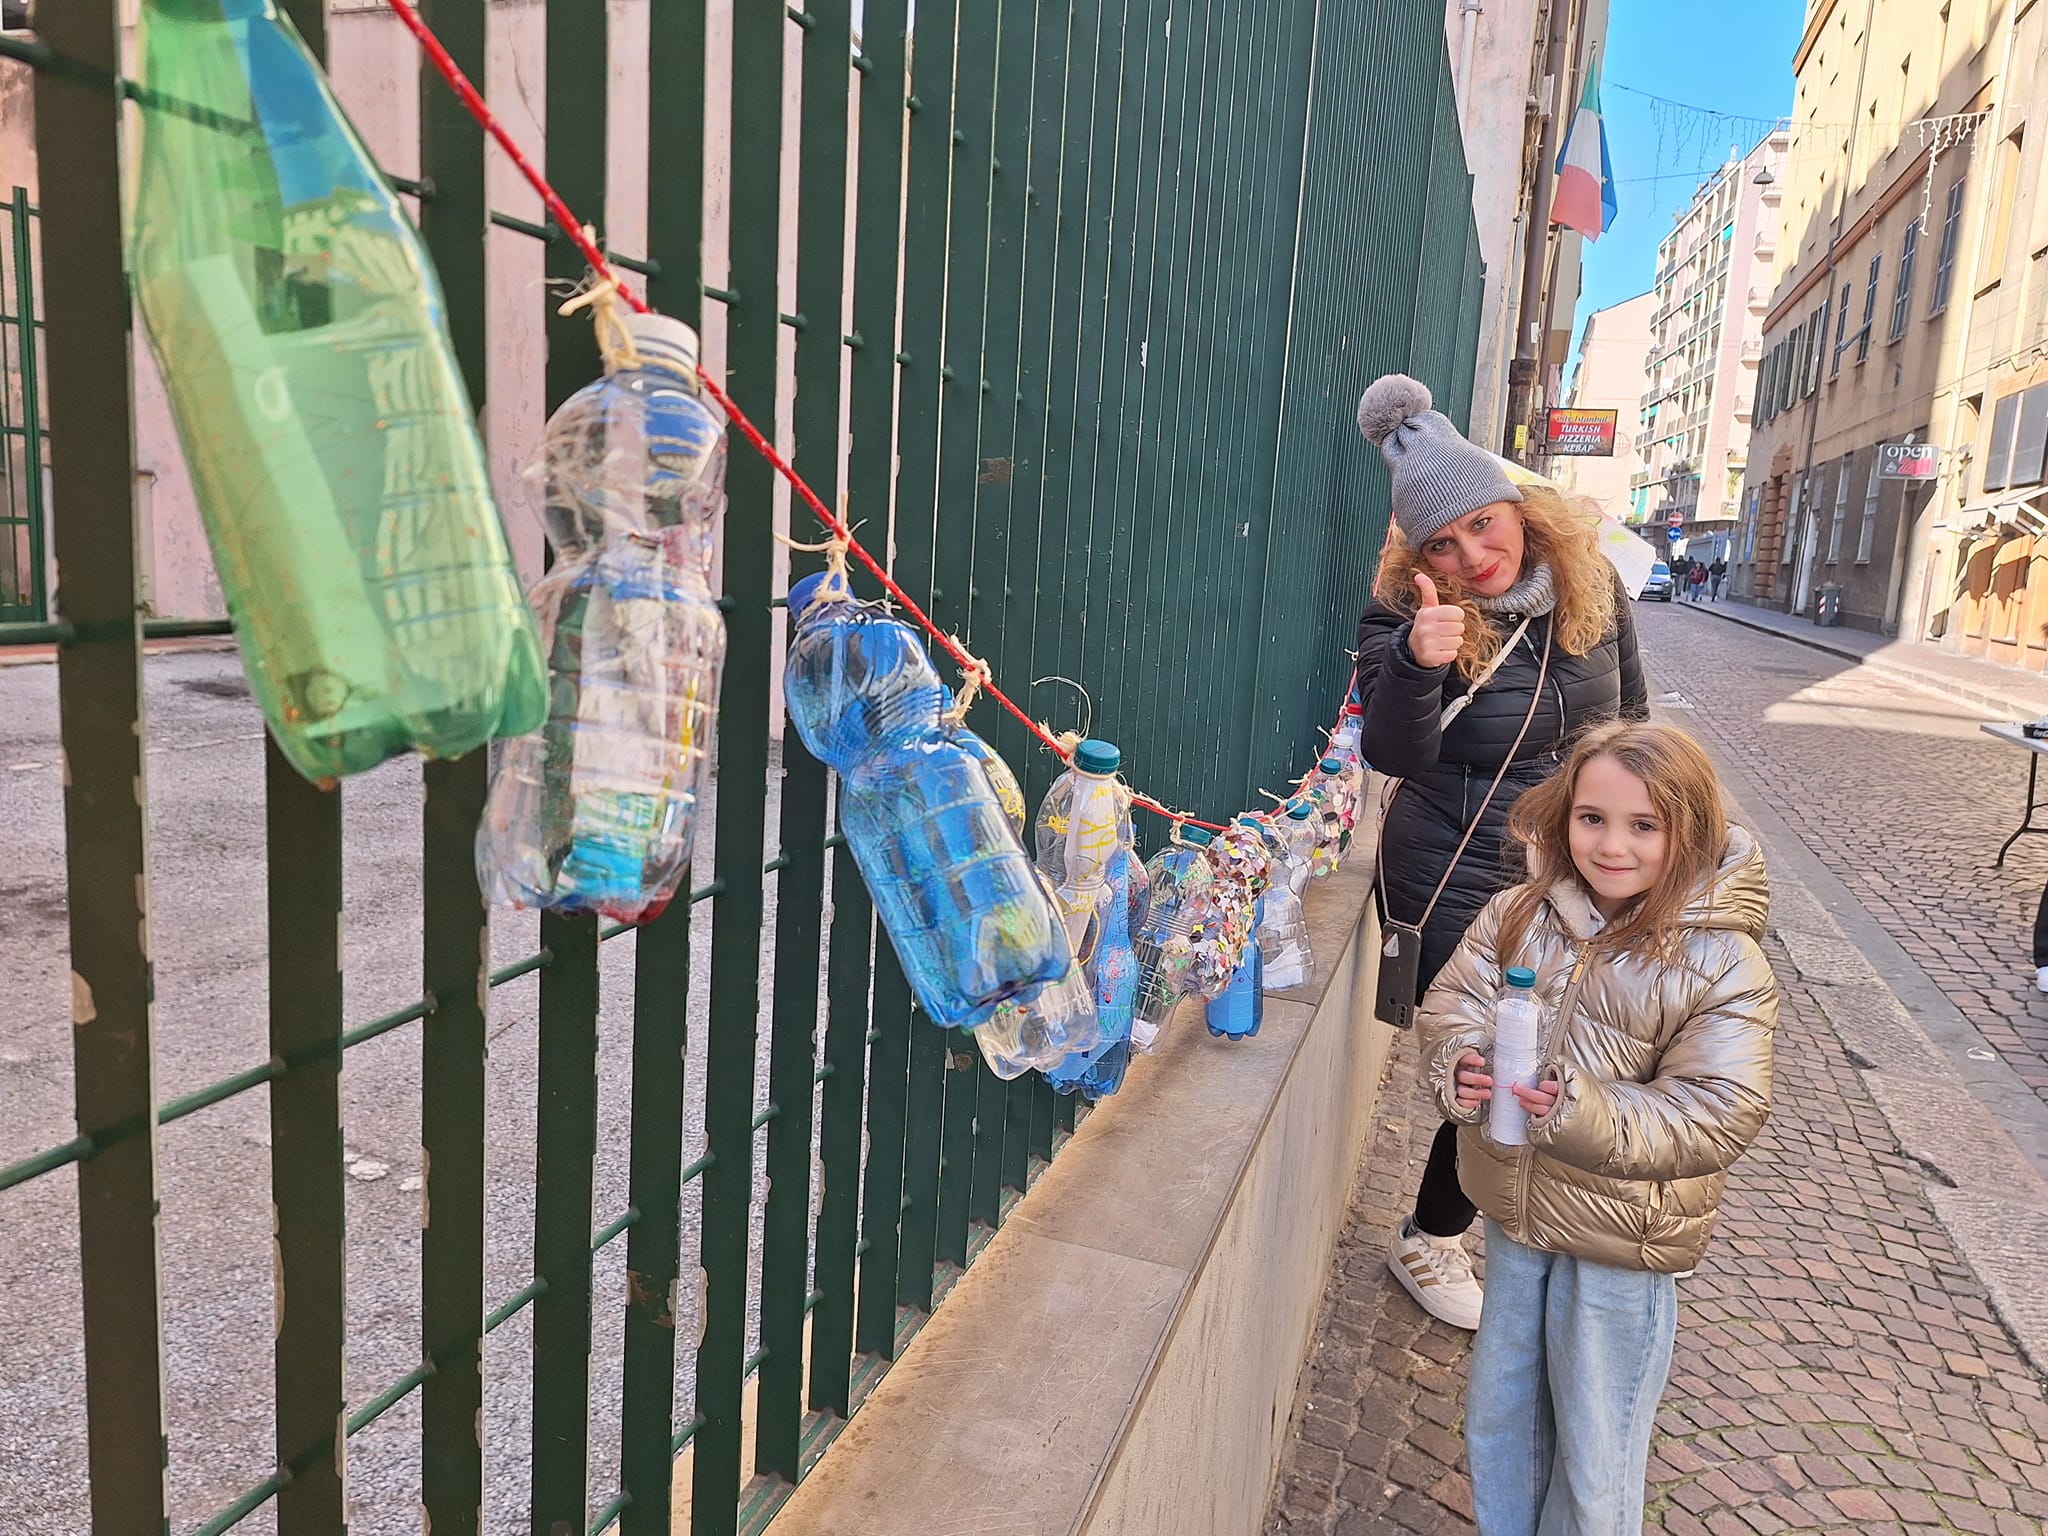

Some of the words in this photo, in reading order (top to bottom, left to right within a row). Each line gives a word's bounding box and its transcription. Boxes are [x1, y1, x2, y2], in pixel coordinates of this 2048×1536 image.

[1561, 425, 1601, 433] TURKISH
[1558, 434, 1601, 443] PIZZERIA
[1563, 444, 1594, 453] KEBAP
[1887, 446, 1933, 461] open
